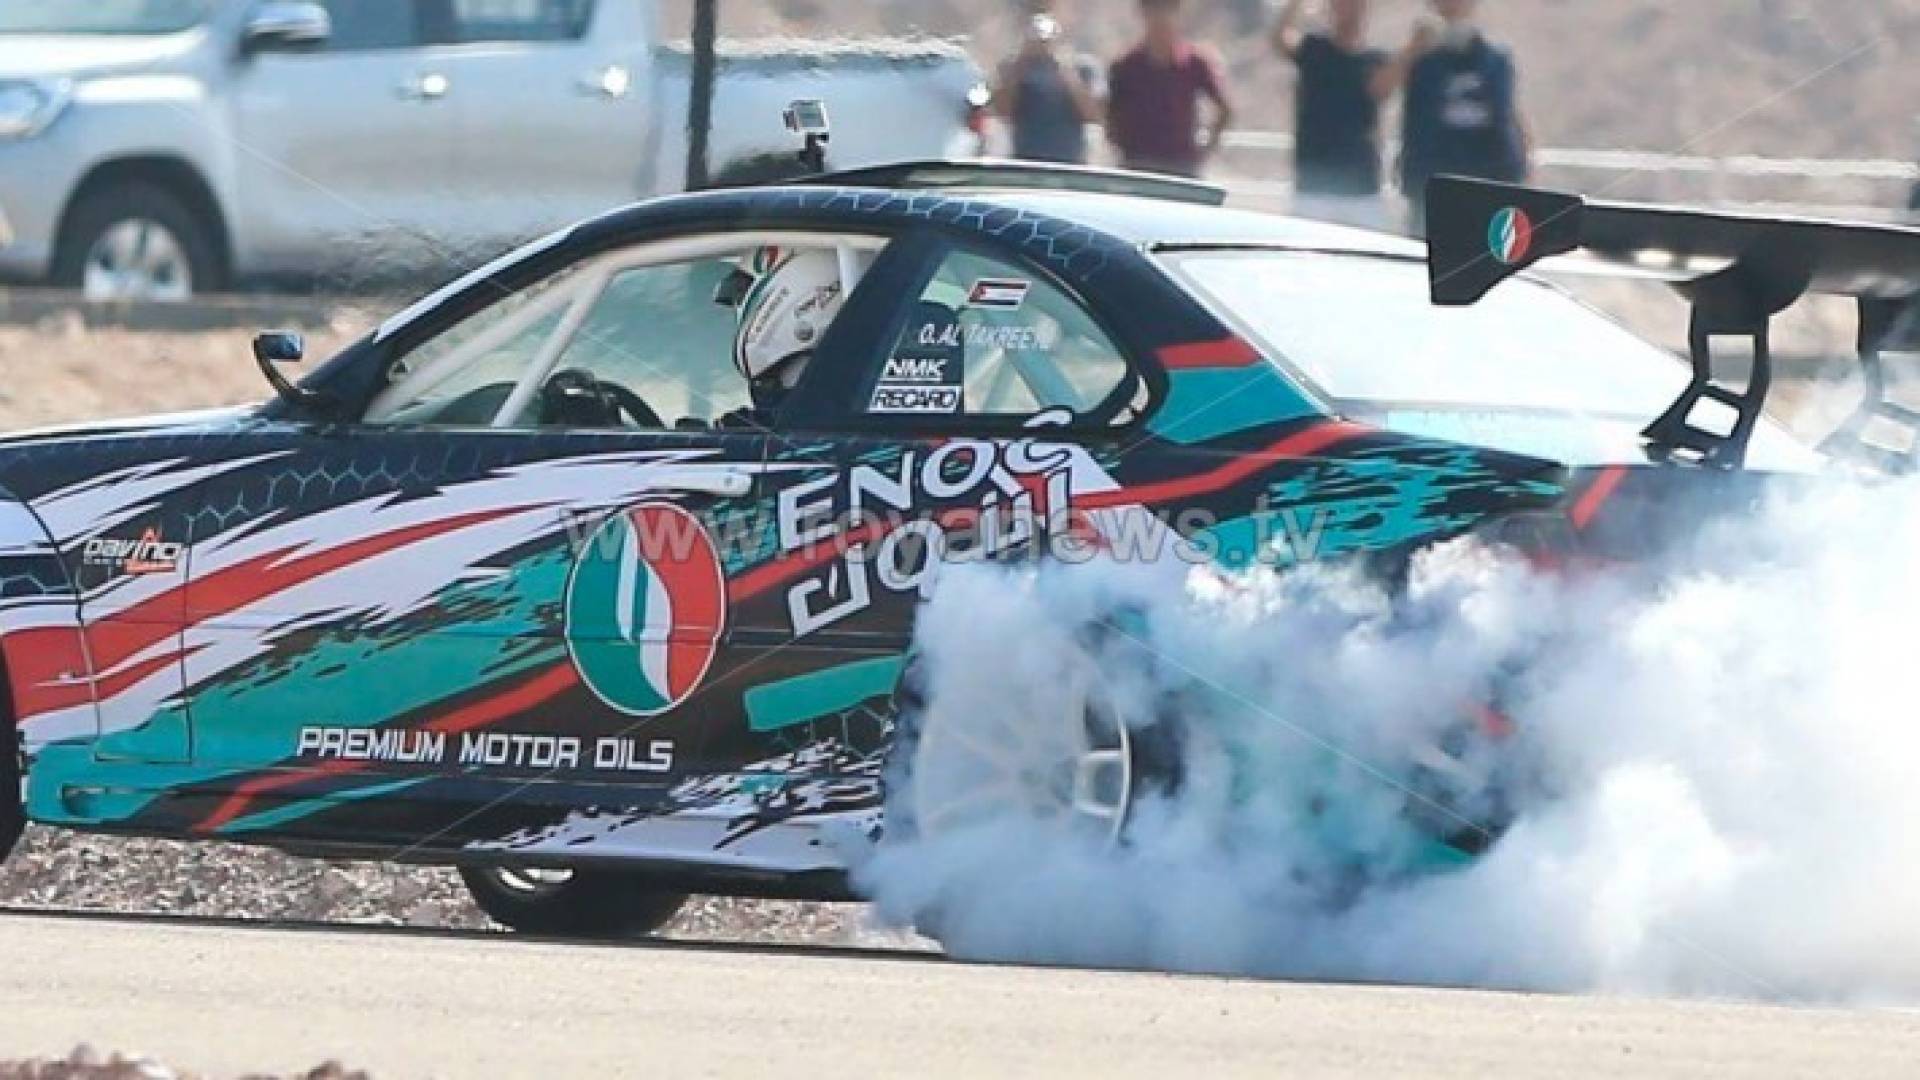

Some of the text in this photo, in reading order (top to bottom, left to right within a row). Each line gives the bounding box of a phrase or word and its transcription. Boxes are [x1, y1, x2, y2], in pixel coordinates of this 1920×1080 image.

[882, 357, 949, 378] NMK
[778, 409, 1074, 551] ENOC
[296, 726, 675, 773] PREMIUM MOTOR OILS
